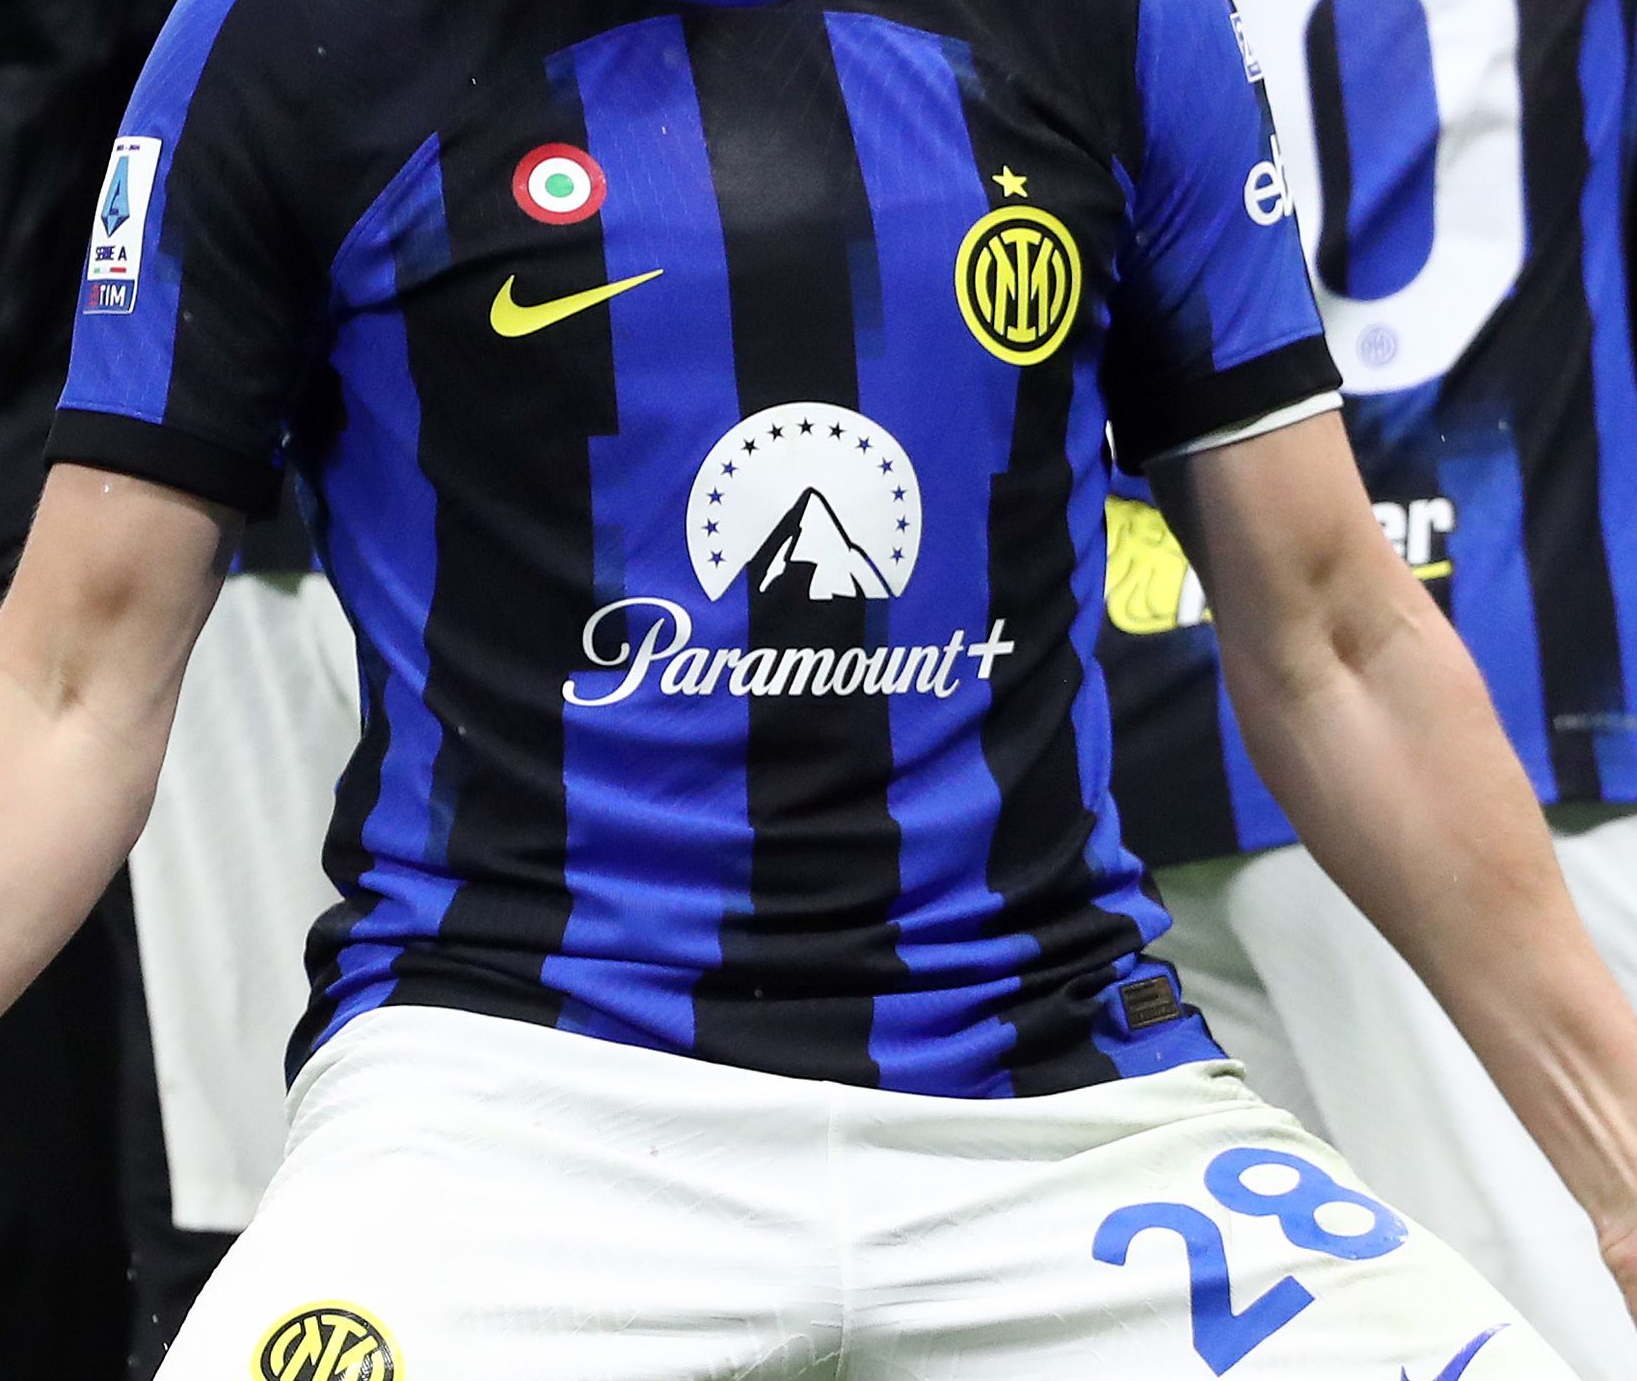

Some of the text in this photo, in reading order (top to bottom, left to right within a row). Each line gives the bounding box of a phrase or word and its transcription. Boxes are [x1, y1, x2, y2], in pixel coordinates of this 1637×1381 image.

[117, 245, 128, 261] A
[98, 284, 126, 308] TIM
[562, 596, 1016, 707] Paramount+
[1091, 1146, 1410, 1378] 28
